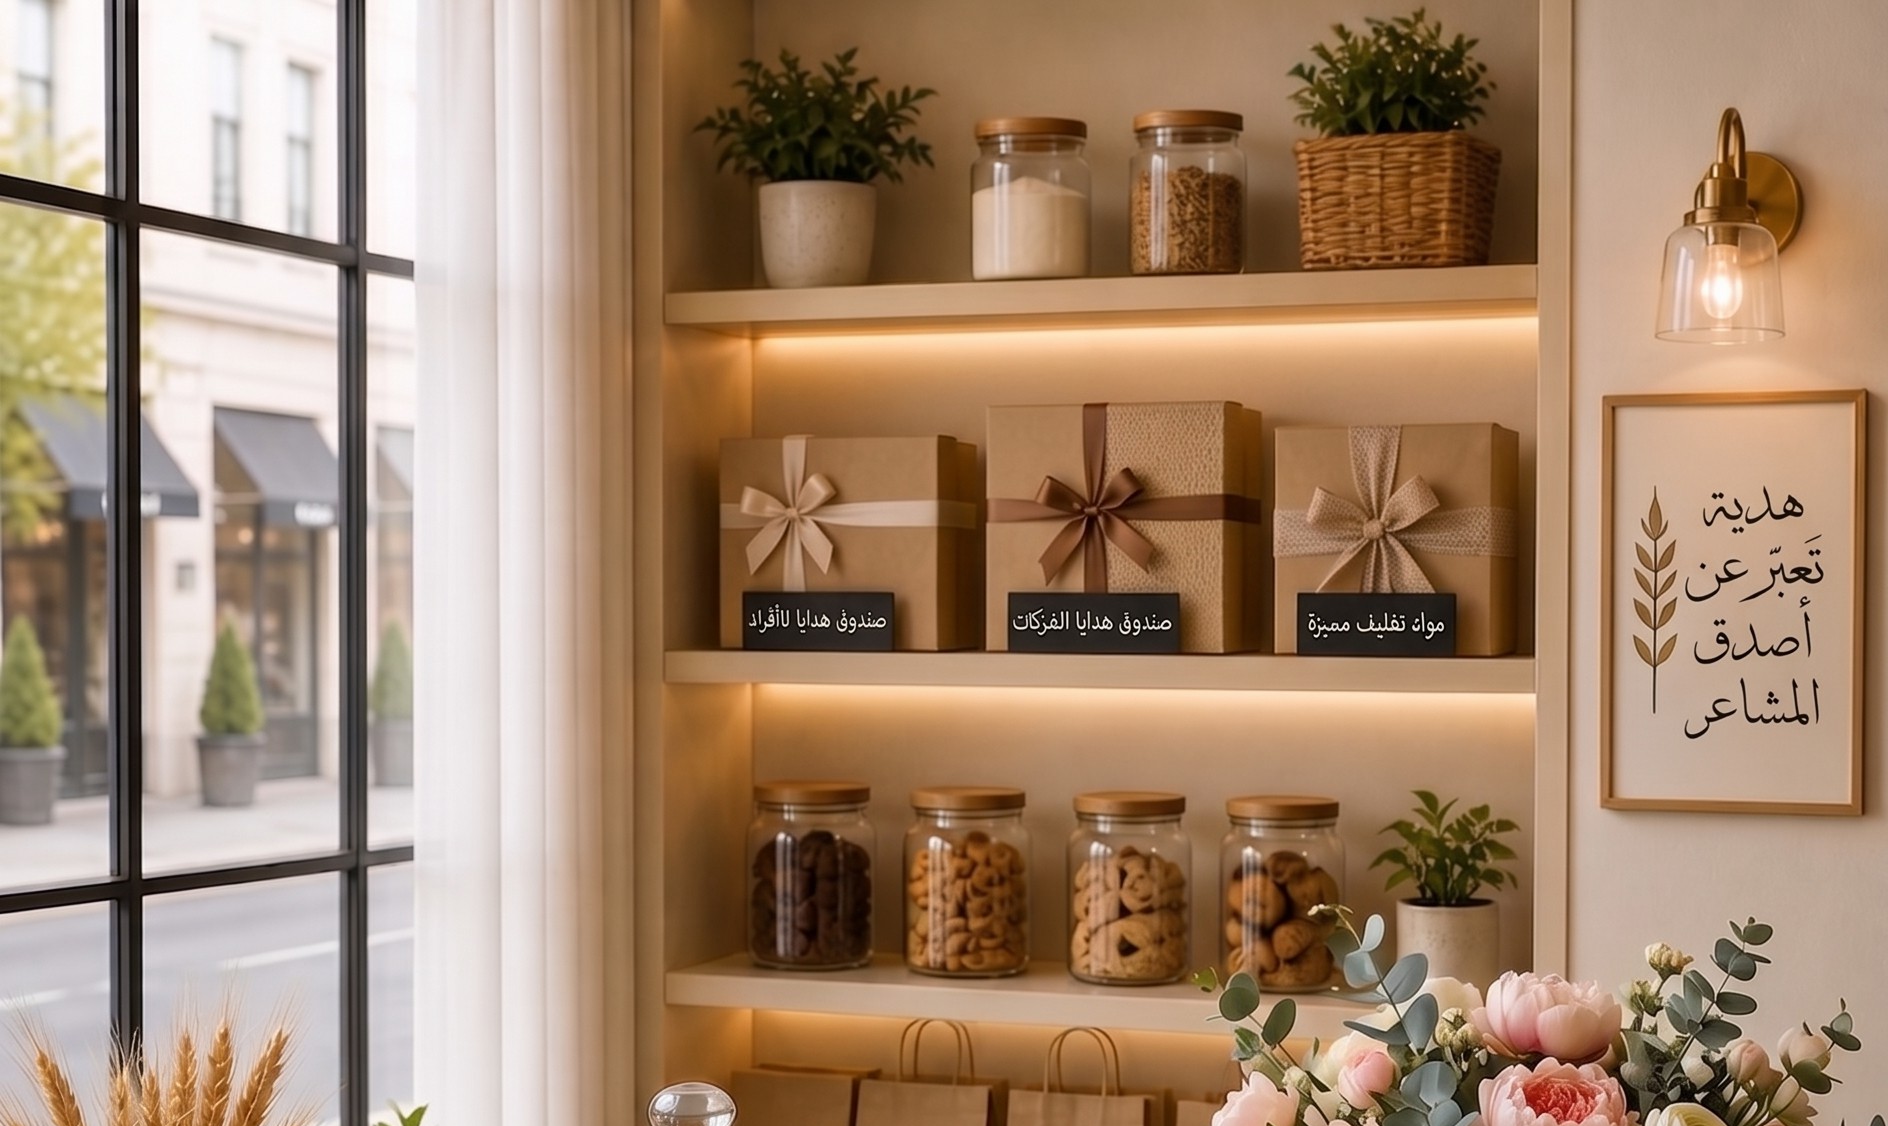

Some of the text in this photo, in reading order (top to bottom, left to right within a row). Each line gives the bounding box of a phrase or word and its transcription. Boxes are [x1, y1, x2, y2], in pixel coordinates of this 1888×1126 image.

[1703, 486, 1803, 533] هدية
[1685, 558, 1749, 602] عن
[797, 610, 830, 633] هدايا
[1077, 611, 1113, 635] هدايا
[1694, 596, 1811, 664] أصدق
[1685, 678, 1819, 739] المشاعر
